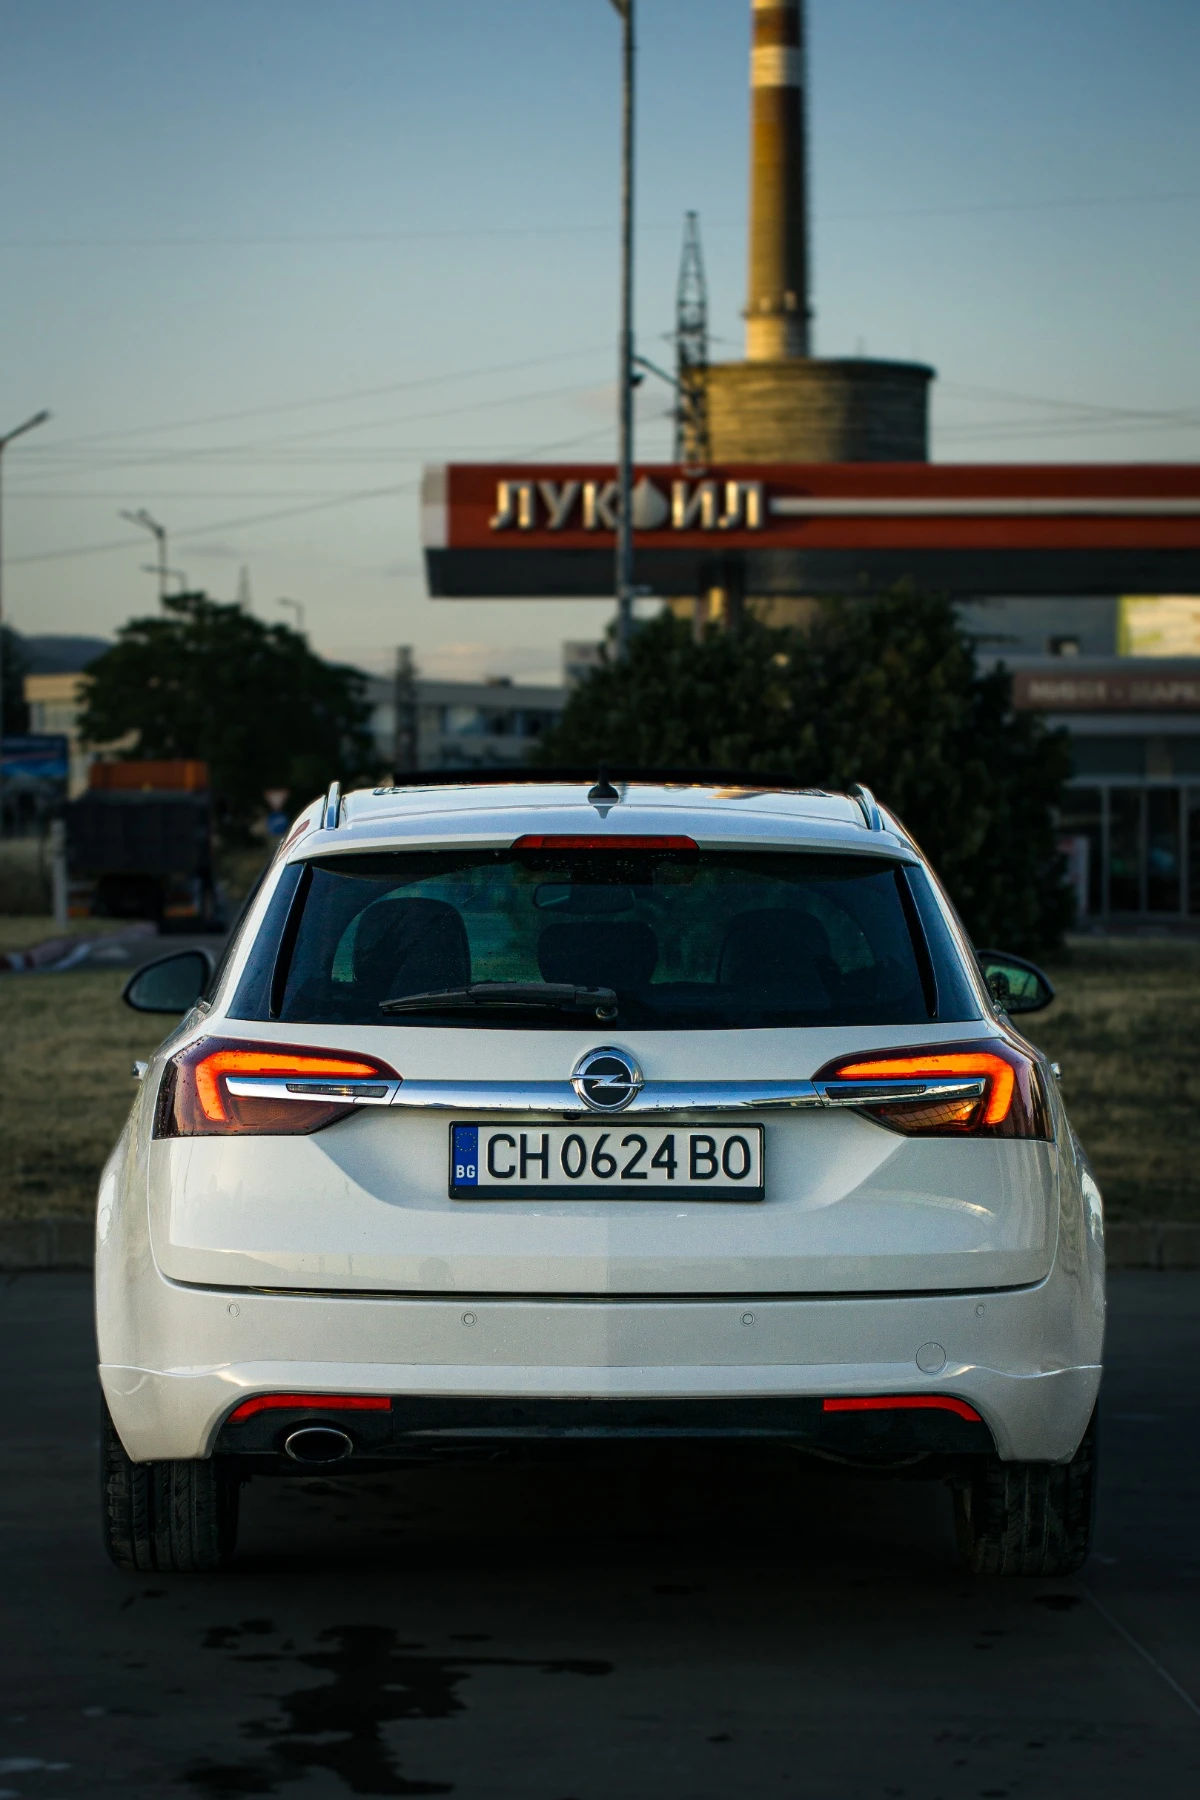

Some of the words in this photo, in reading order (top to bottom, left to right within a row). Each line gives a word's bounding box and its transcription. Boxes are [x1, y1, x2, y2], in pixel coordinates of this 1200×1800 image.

[487, 1133, 549, 1179] CH
[560, 1133, 678, 1179] 0624
[455, 1164, 476, 1179] BG
